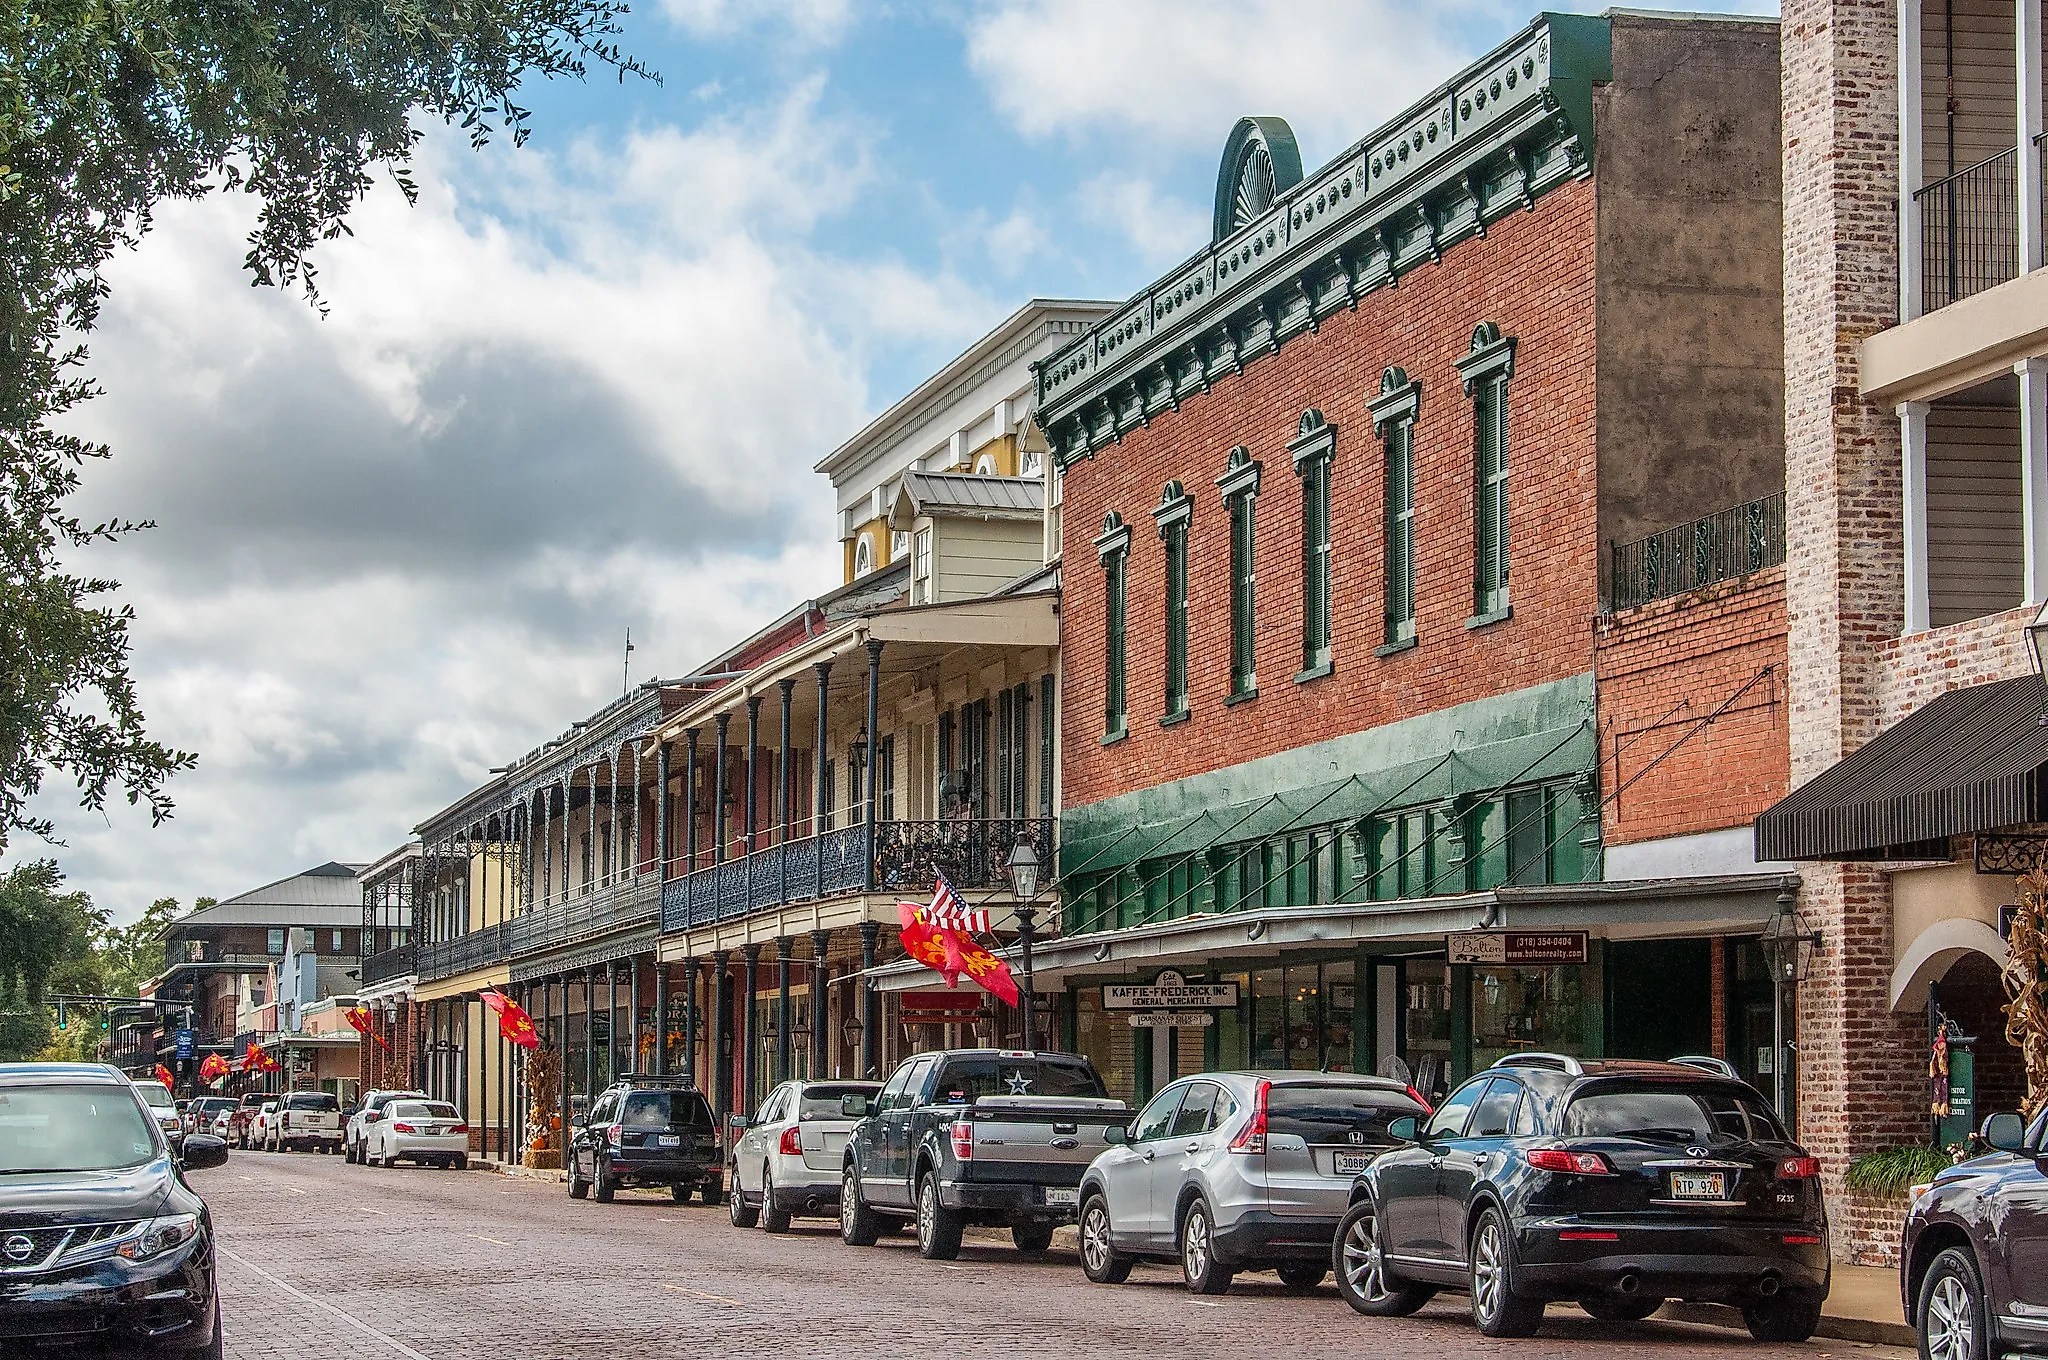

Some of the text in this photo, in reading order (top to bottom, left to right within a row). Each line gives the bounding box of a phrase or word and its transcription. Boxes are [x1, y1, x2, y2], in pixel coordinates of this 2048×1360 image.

[1452, 939, 1504, 953] Bolton
[1516, 937, 1572, 947] (318) 354-0404
[1507, 949, 1582, 959] www.boltonrealty.com
[1132, 997, 1212, 1006] GENERAL MERCANTILE
[1949, 1107, 1966, 1116] CENTER
[1675, 1180, 1719, 1194] RTP 920
[1776, 1194, 1795, 1203] FX35
